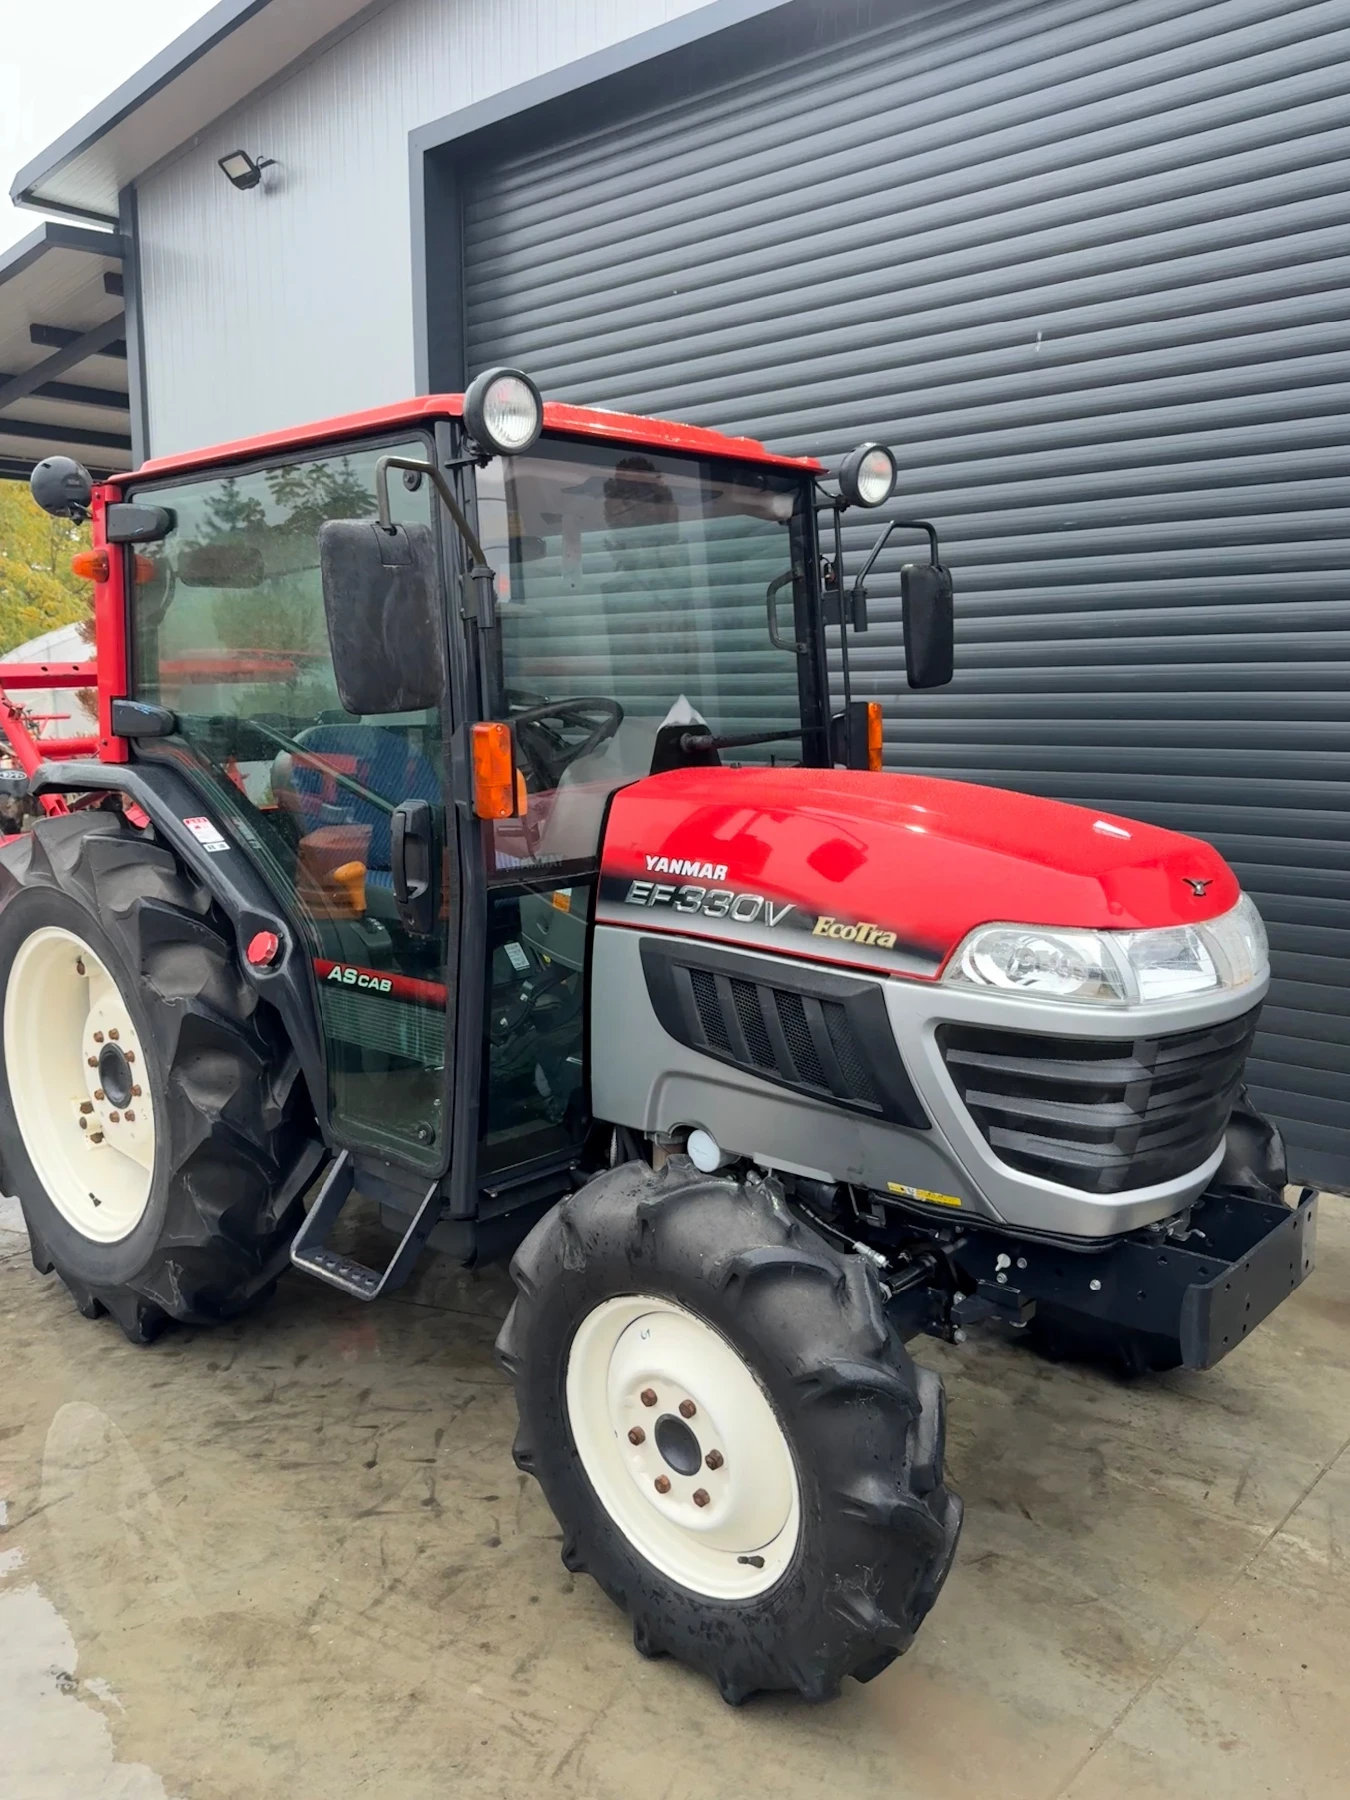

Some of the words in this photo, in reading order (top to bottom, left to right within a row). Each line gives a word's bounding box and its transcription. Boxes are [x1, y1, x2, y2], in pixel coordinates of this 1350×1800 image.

[645, 855, 729, 880] YANMAR
[624, 879, 797, 927] EF330V
[812, 915, 898, 949] EcoTra
